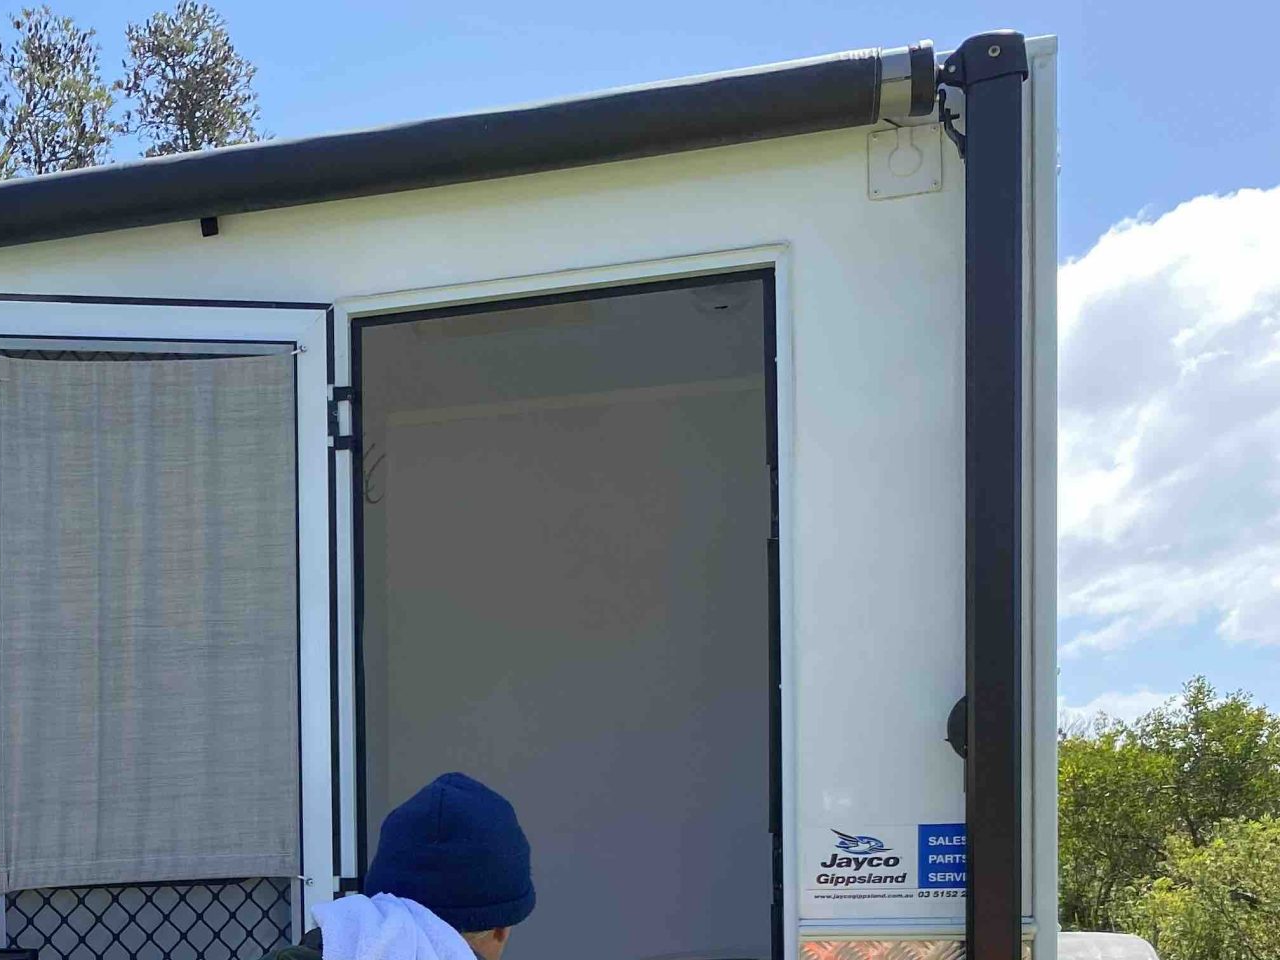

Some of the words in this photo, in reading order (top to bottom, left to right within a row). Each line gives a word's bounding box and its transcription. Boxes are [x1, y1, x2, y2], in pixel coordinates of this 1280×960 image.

[820, 853, 901, 871] Jayco
[815, 872, 908, 887] Gippsland
[917, 890, 931, 898] 03
[933, 890, 958, 898] 5152
